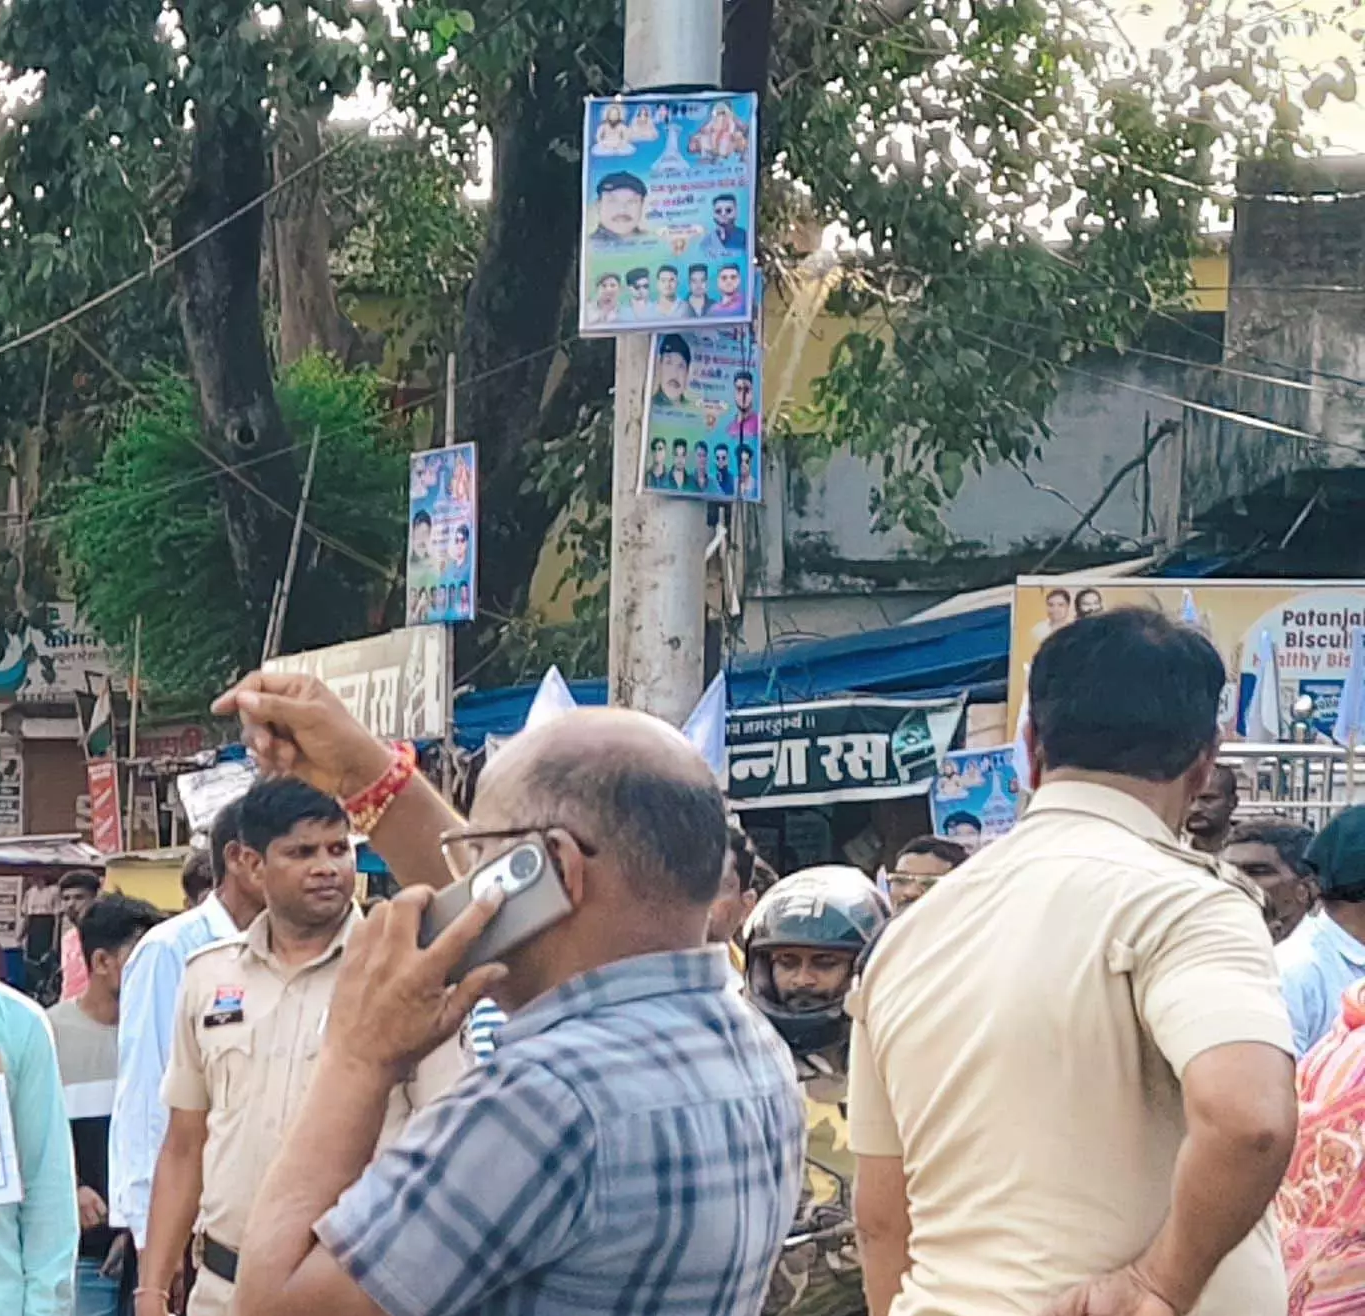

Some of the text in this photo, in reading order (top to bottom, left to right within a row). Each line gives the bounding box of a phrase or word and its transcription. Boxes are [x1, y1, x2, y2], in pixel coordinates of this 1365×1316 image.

[1282, 607, 1365, 631] Patanja
[1285, 630, 1353, 649] Biscui
[729, 733, 891, 787] न्ना रस
